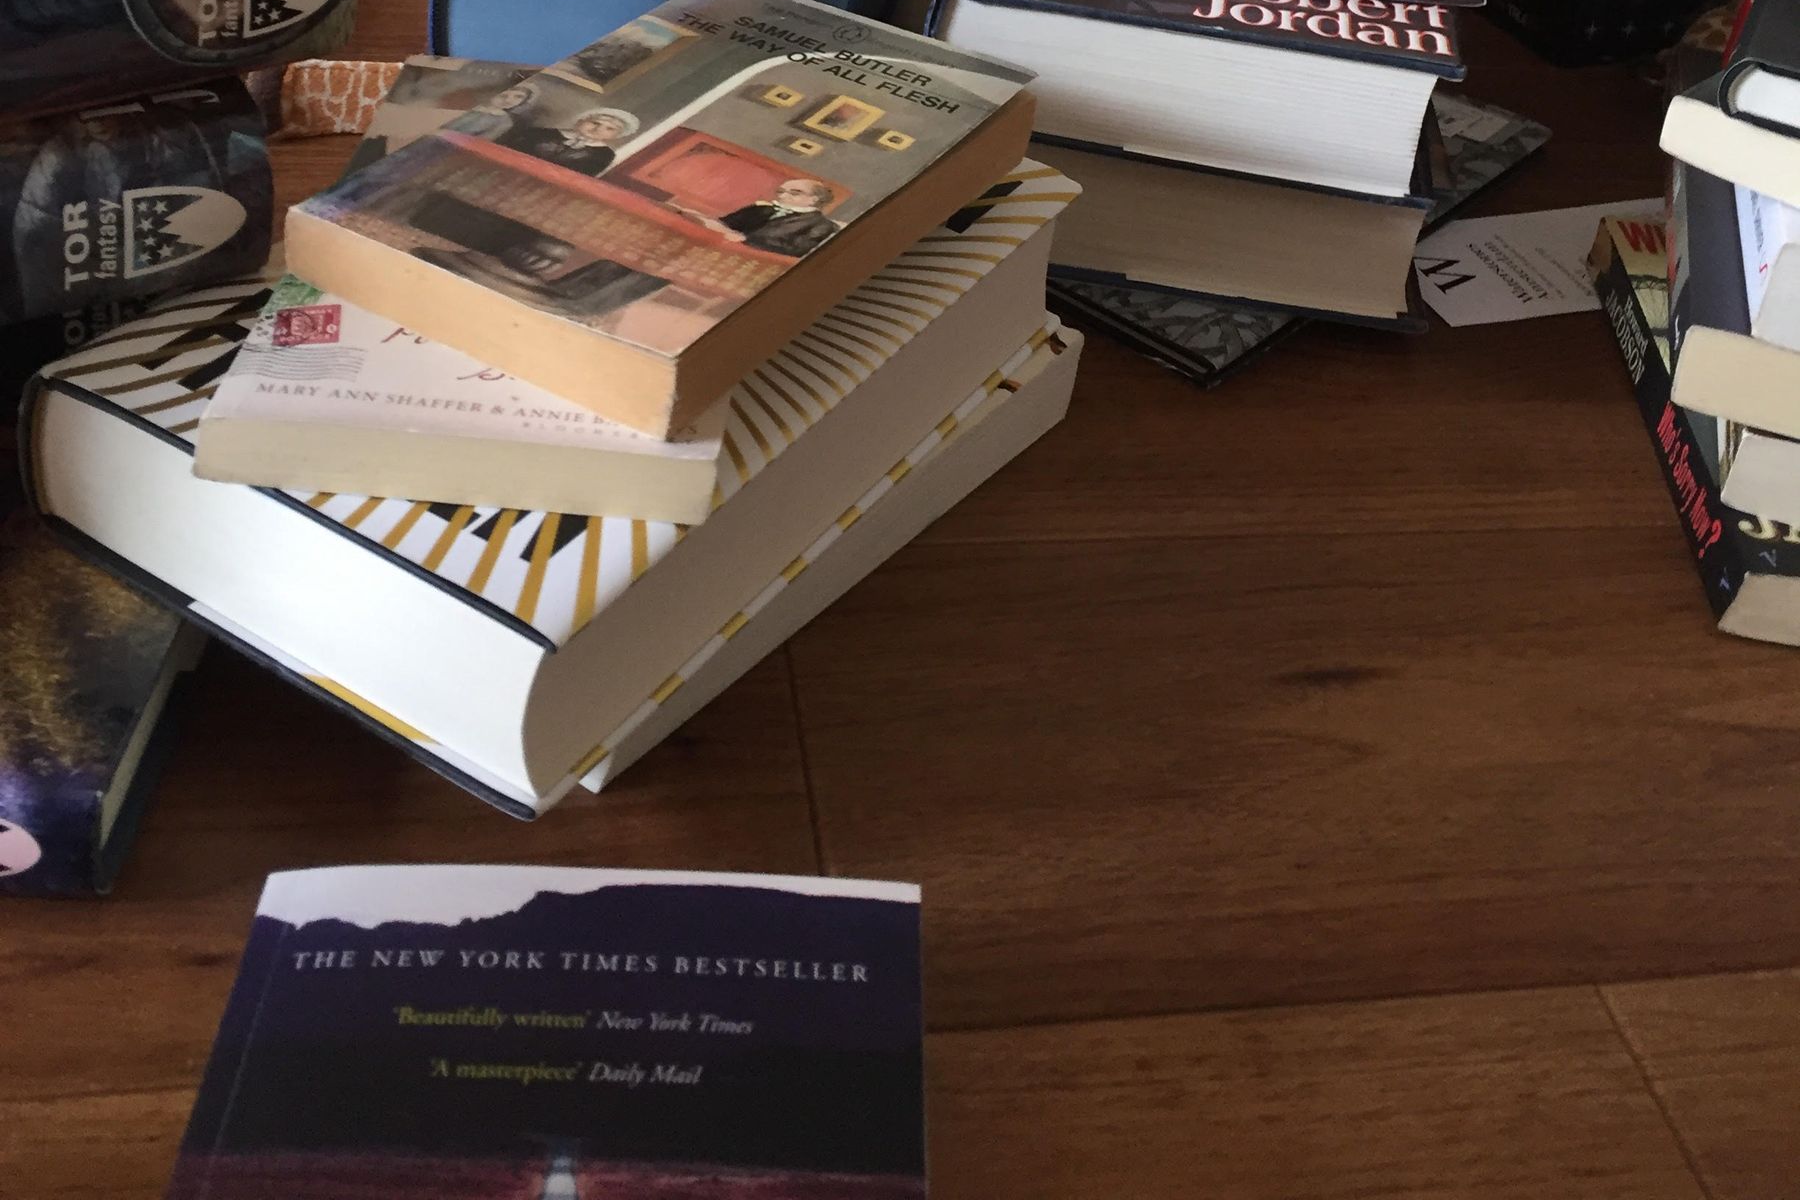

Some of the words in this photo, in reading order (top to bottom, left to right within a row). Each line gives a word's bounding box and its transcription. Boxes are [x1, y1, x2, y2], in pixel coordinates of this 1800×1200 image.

[678, 12, 725, 35] THE
[729, 30, 783, 53] WAY
[787, 51, 825, 66] OF
[822, 65, 867, 86] ALL
[875, 81, 960, 114] FLESH
[734, 16, 827, 54] SAMUEL
[834, 49, 932, 87] BUTLER
[63, 200, 90, 291] TOR
[94, 197, 121, 279] fantasy
[1605, 289, 1645, 384] JACOBSON
[256, 383, 320, 397] MARY
[327, 388, 379, 402] ANN
[385, 394, 482, 412] SHAFFER
[512, 407, 586, 423] ANNIE
[294, 950, 354, 970] THE
[370, 950, 444, 969] NEW
[459, 951, 544, 970] YORK
[560, 952, 657, 973] TIMES
[674, 956, 868, 983] BESTSELLER
[597, 1010, 643, 1030] New
[649, 1012, 691, 1032] York
[700, 1013, 753, 1035] Times
[589, 1062, 645, 1089] Daily
[650, 1064, 703, 1084] Mail
